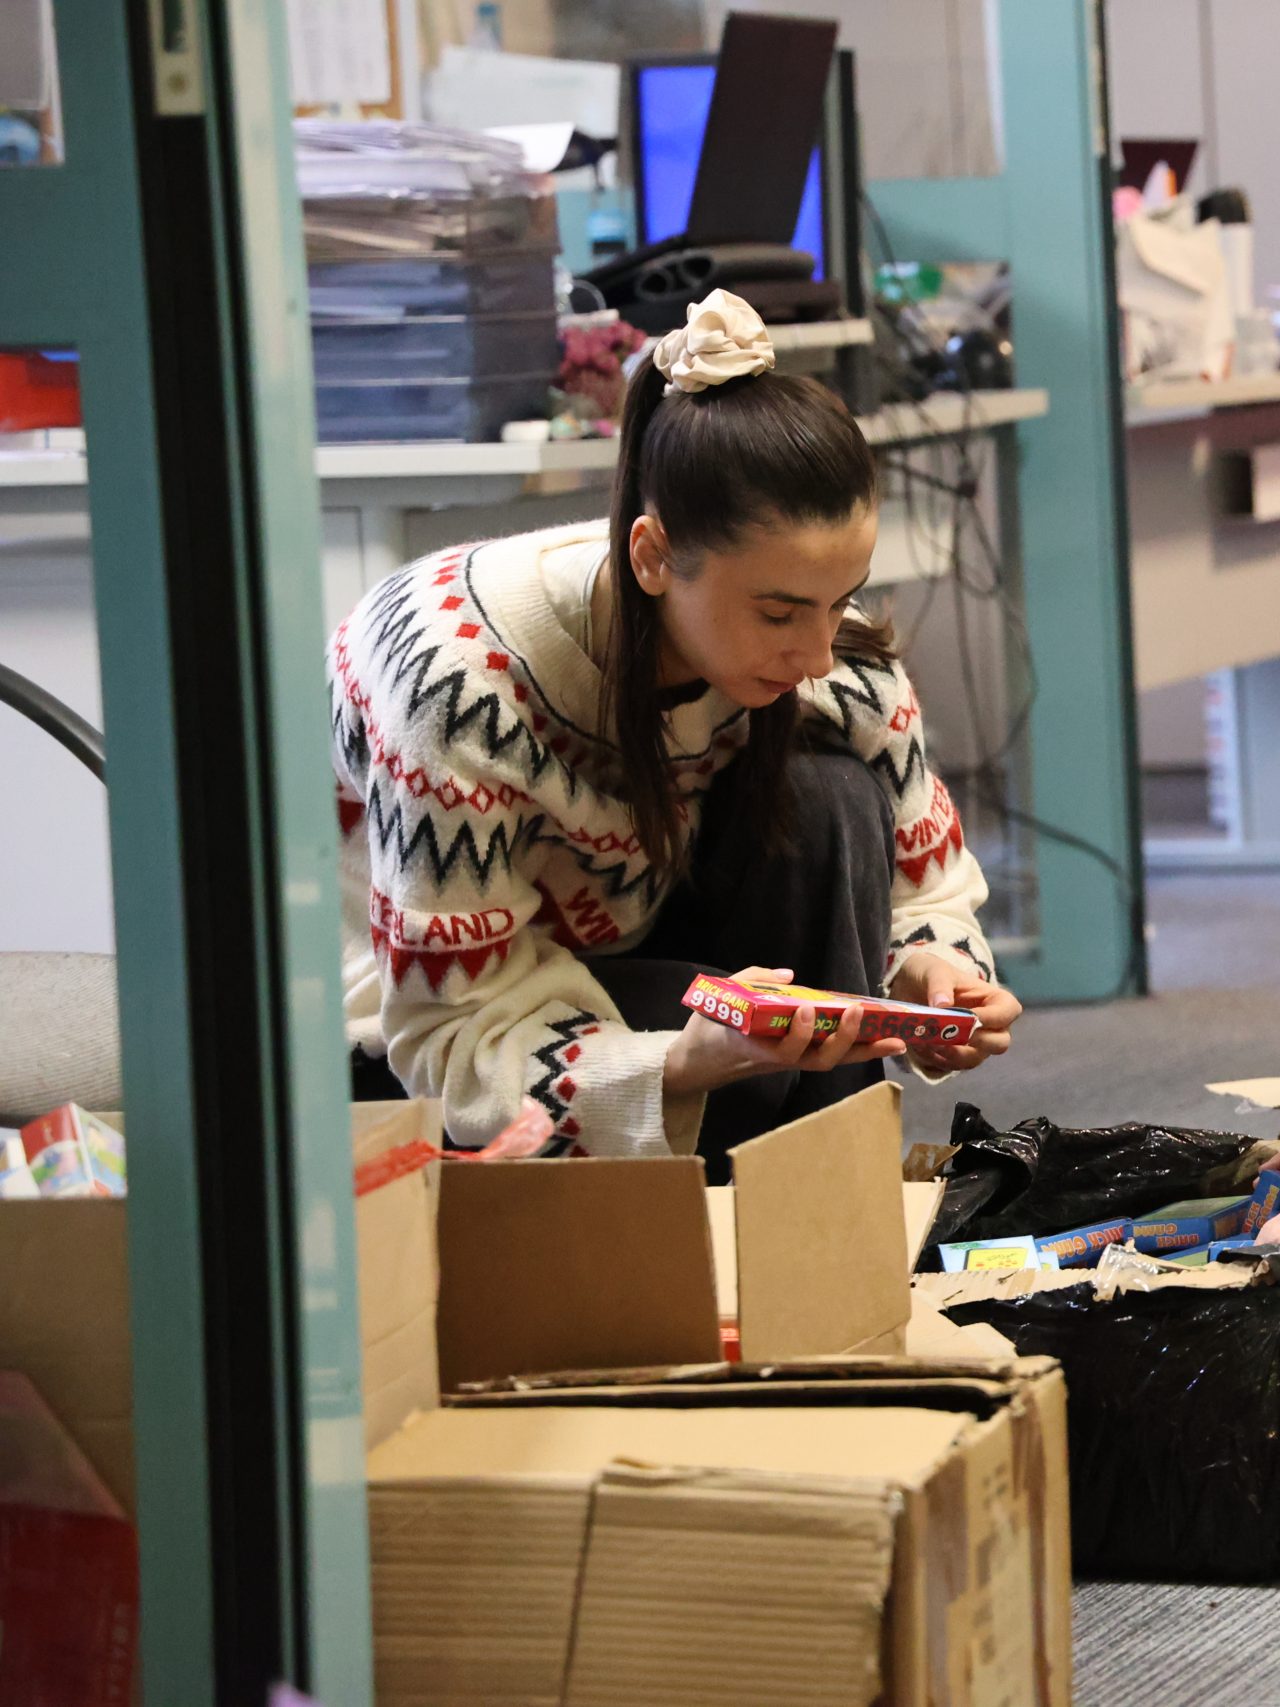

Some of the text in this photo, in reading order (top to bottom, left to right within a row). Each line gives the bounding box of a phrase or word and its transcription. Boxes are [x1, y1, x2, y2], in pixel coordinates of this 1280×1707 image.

[690, 990, 744, 1027] 9999
[695, 978, 750, 1013] BRICK GAME
